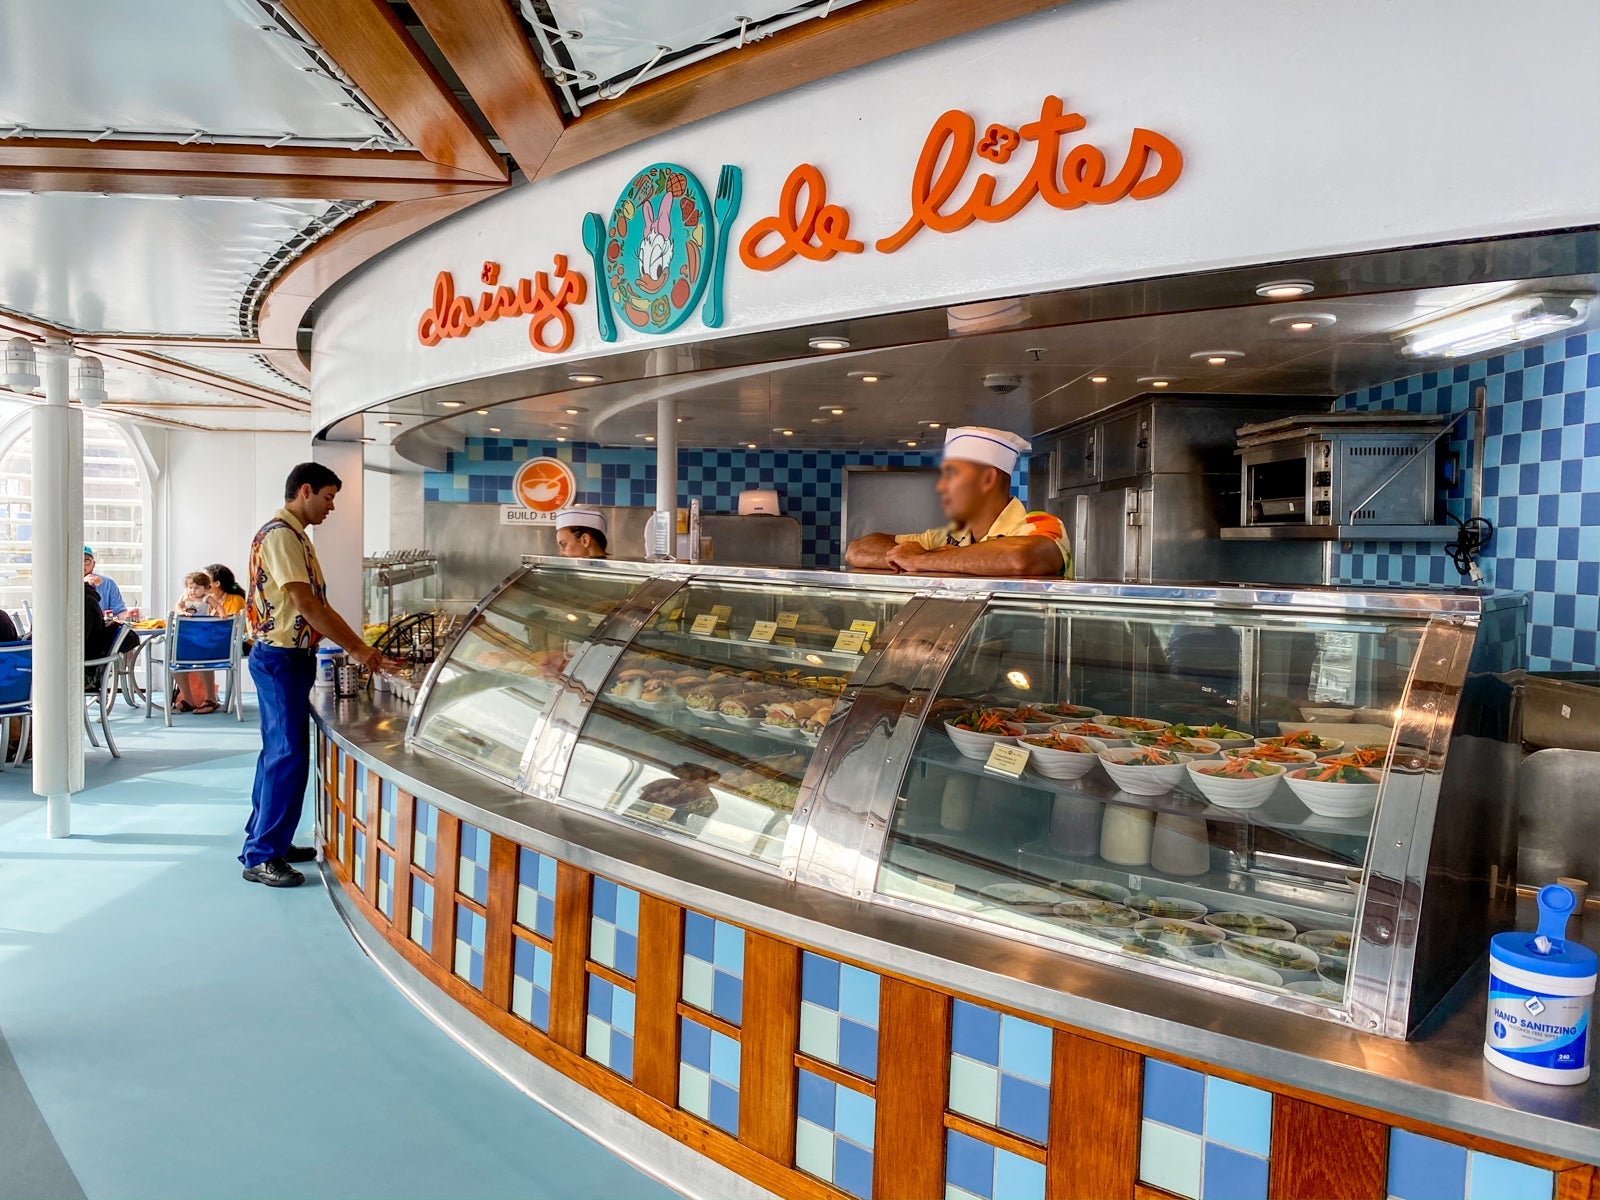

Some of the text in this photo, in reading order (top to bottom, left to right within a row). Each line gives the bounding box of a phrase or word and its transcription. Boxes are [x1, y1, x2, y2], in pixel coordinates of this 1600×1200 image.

[418, 94, 1184, 353] daisy's de lites
[507, 511, 538, 521] BUILD
[540, 512, 547, 520] A
[1494, 1008, 1517, 1024] HAND
[1520, 1020, 1577, 1035] SANITIZING
